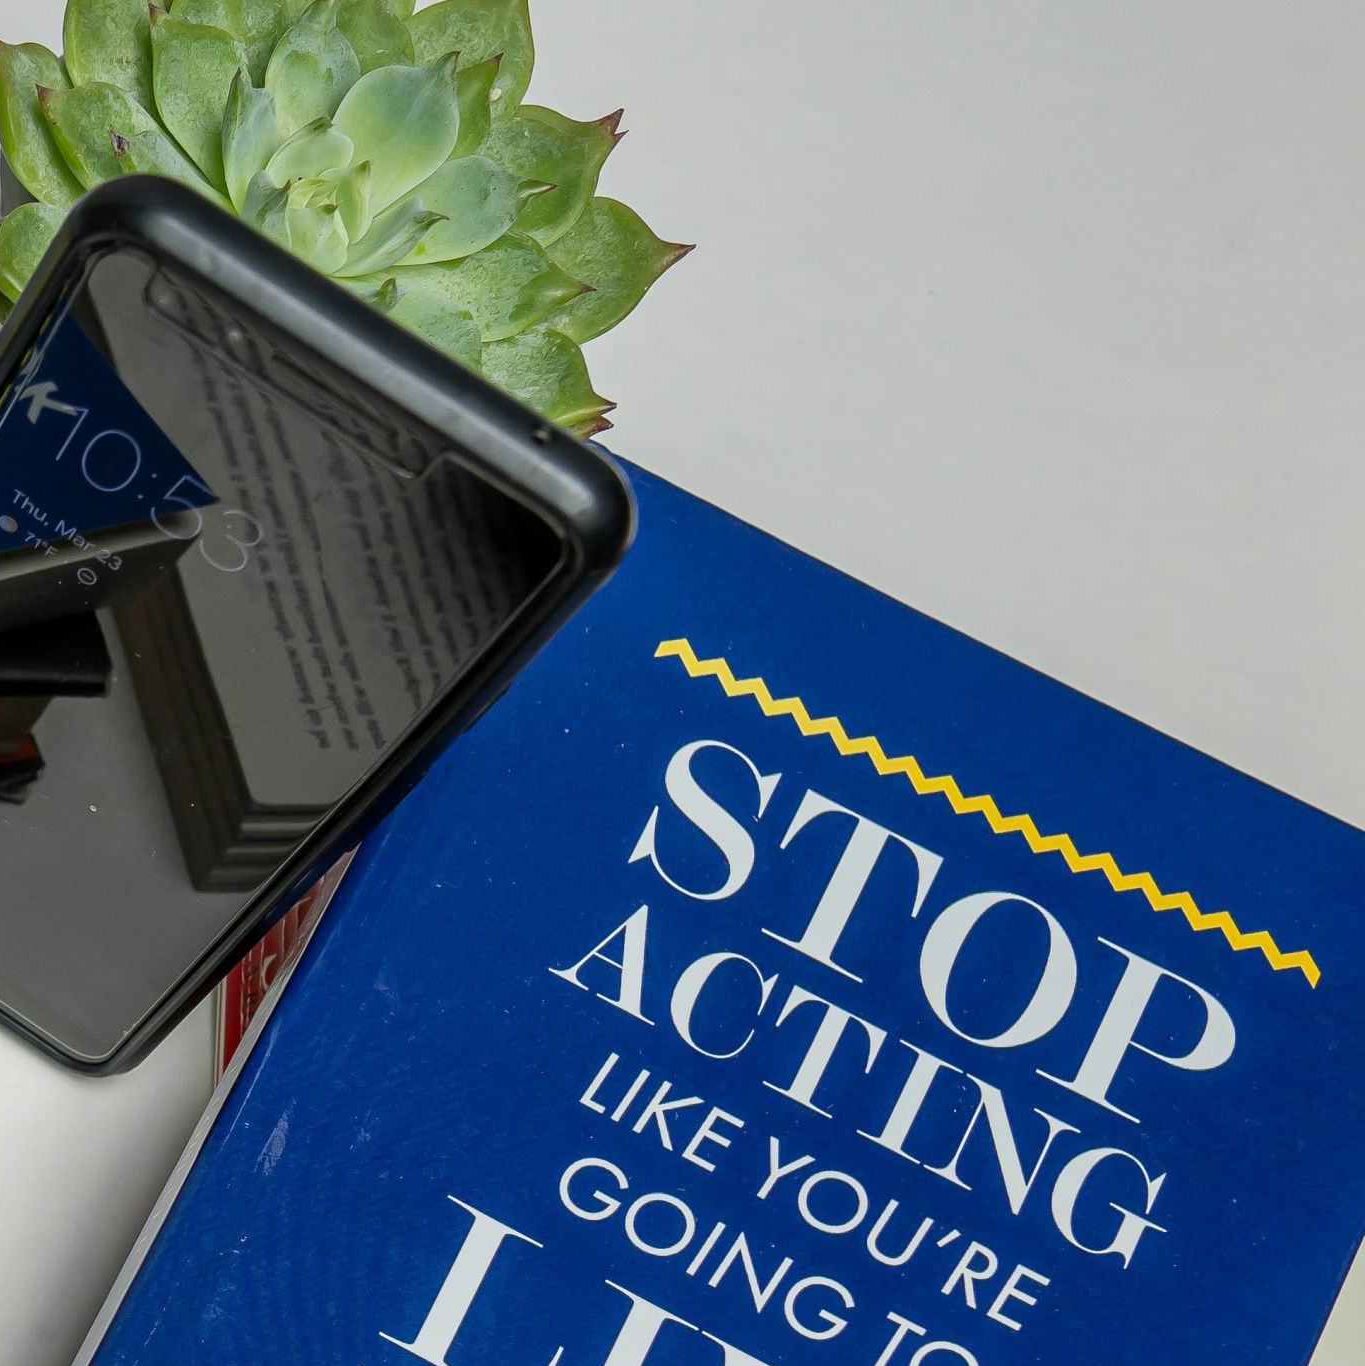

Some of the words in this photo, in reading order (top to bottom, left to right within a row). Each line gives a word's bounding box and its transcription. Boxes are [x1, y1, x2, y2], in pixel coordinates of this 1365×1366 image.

[13, 488, 50, 527] Thu,
[54, 519, 95, 552] Mar
[97, 549, 123, 571] 23
[628, 740, 1235, 1123] STOP
[549, 905, 1166, 1269] ACTING
[580, 1053, 744, 1171] LIKE
[757, 1136, 1050, 1330] YOU’RE
[560, 1158, 854, 1339] GOING
